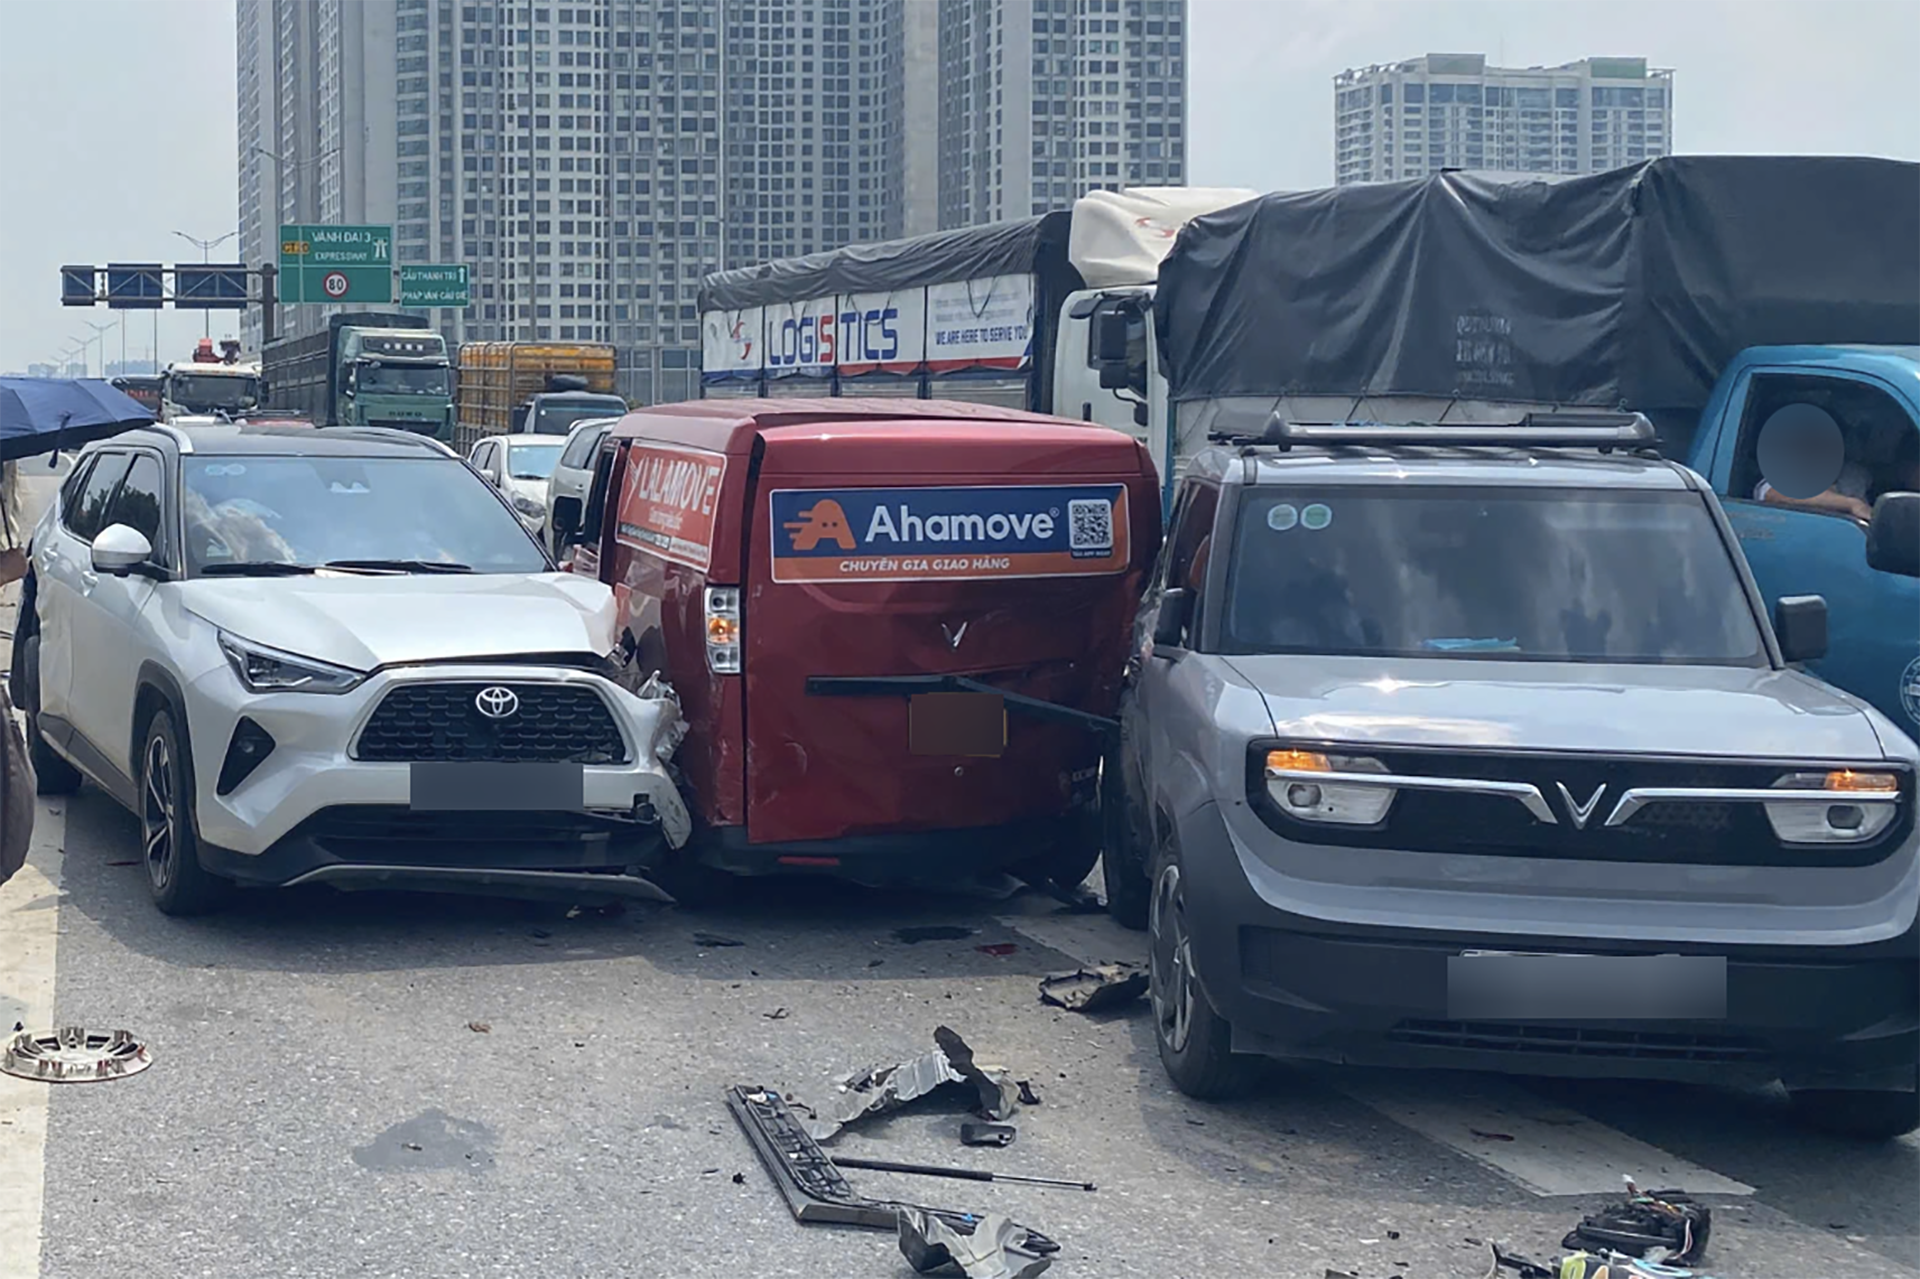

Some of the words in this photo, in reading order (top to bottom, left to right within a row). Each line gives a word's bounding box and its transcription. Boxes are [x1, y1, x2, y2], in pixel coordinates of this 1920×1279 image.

[364, 231, 371, 243] 3
[328, 278, 344, 291] 80
[769, 308, 898, 366] LOGISTICS
[947, 330, 960, 344] ARE
[961, 328, 978, 343] HERE
[979, 328, 988, 342] TO
[989, 326, 1012, 342] SERVE
[639, 456, 721, 515] LALAMOVE
[839, 557, 898, 572] CHUYÊN
[902, 559, 929, 571] GIA
[932, 558, 969, 570] GIAO
